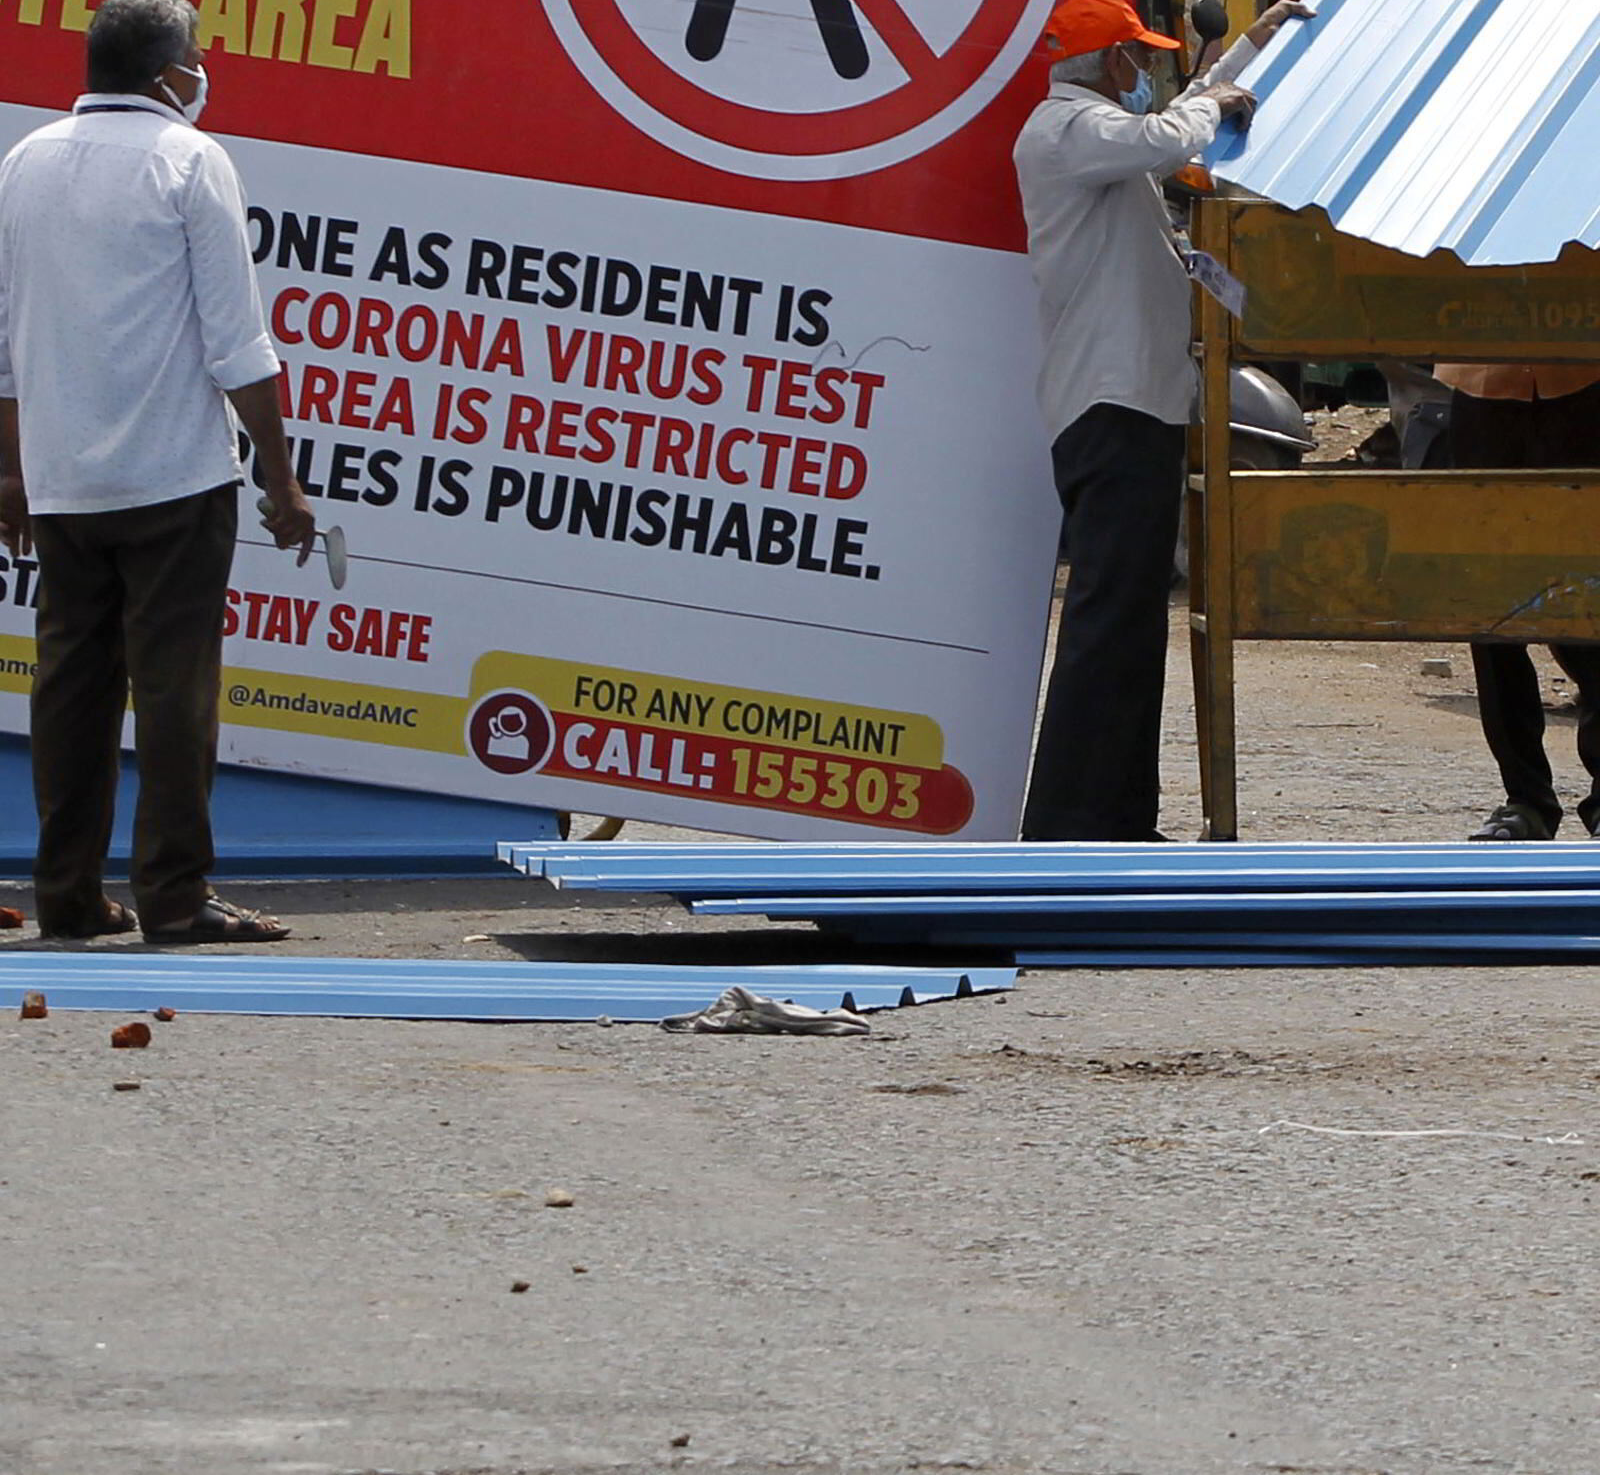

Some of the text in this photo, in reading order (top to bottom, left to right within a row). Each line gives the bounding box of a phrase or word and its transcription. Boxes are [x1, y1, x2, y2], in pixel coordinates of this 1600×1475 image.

[245, 205, 359, 278] ONE
[368, 225, 454, 291] AS
[465, 237, 763, 337] RESIDENT
[775, 284, 834, 348] IS
[270, 286, 525, 377] CORONA
[546, 325, 727, 406] VIRUS
[742, 354, 886, 430] TEST
[432, 383, 494, 445] IS
[503, 393, 870, 500] RESTRICTED
[414, 455, 474, 518] IS
[485, 464, 882, 581] PUNISHABLE.
[222, 588, 320, 646] STAY
[327, 603, 432, 662] SAFE
[228, 684, 419, 728] @AmdavadAMC
[573, 674, 905, 757] FOR ANY COMPLAINT
[562, 720, 923, 821] CALL: 155303
